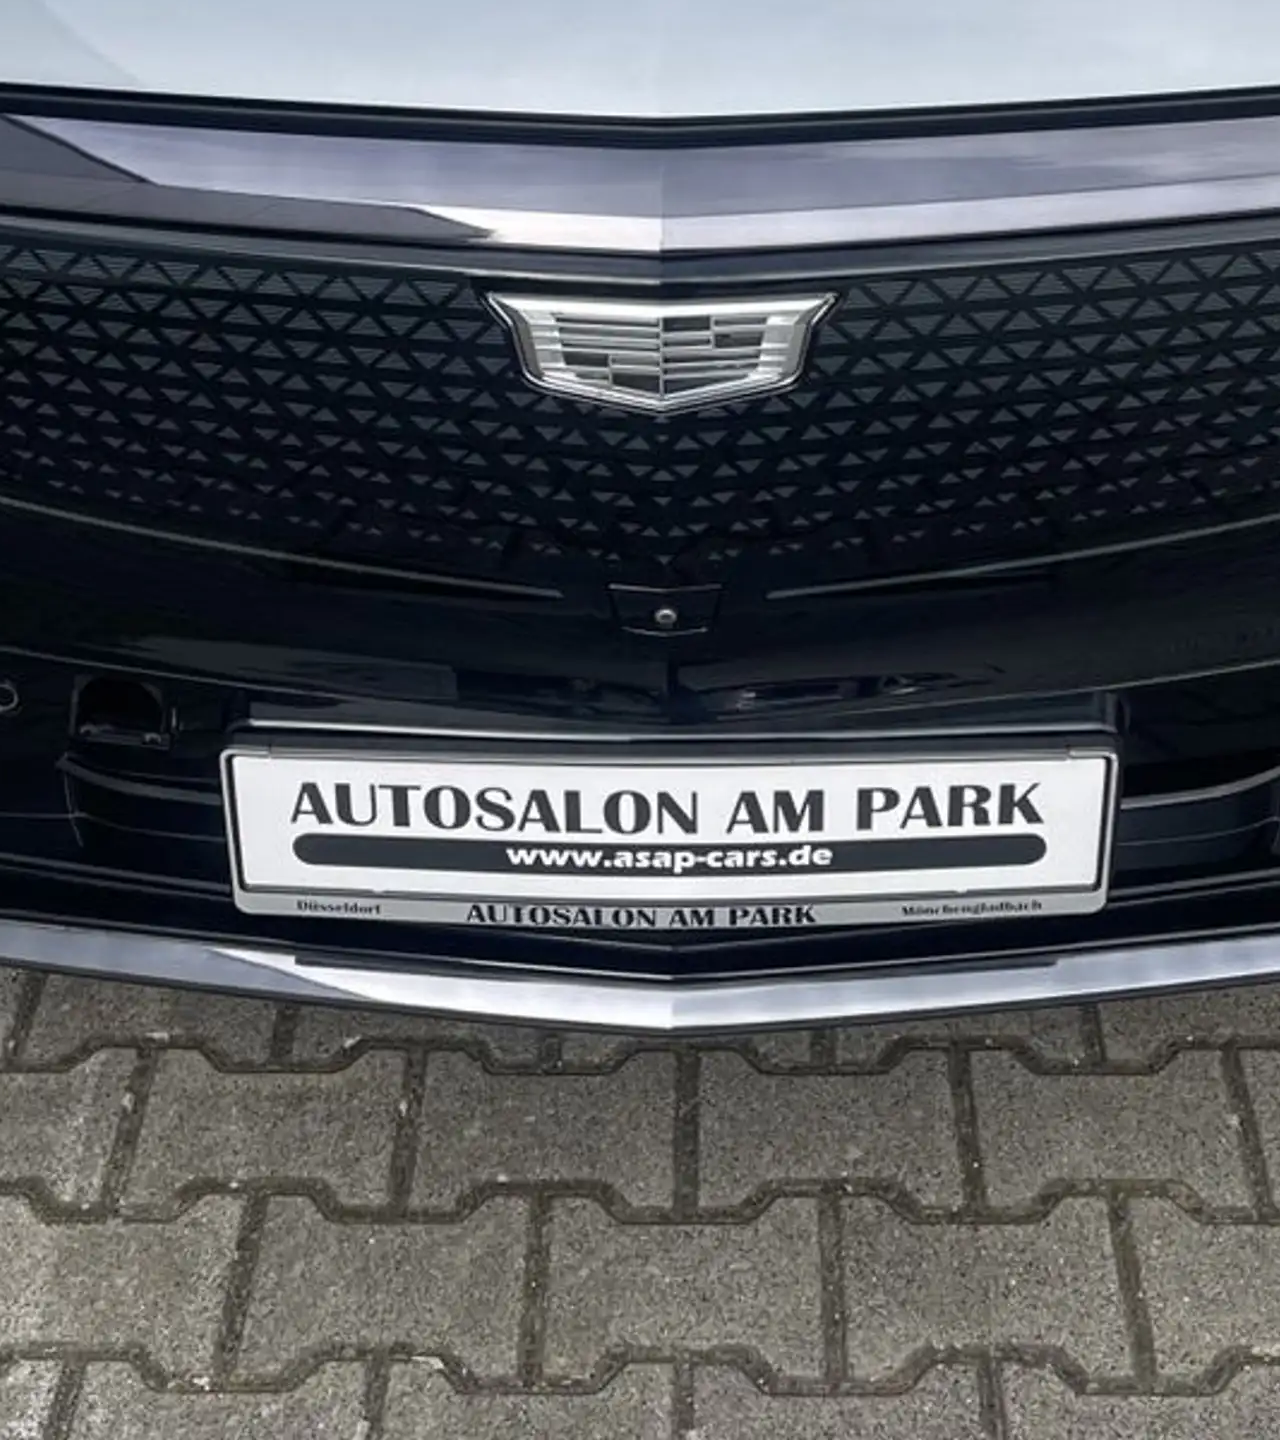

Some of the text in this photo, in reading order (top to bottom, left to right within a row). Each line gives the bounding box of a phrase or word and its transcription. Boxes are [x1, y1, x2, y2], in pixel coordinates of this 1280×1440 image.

[290, 781, 1045, 835] AUTOSALON AM PARK
[506, 845, 833, 875] www.asap-cars.de
[297, 899, 381, 915] Düsseldorf
[466, 903, 817, 928] AUTOSALON AM PARK
[901, 899, 1043, 917] Mönchengladbach
